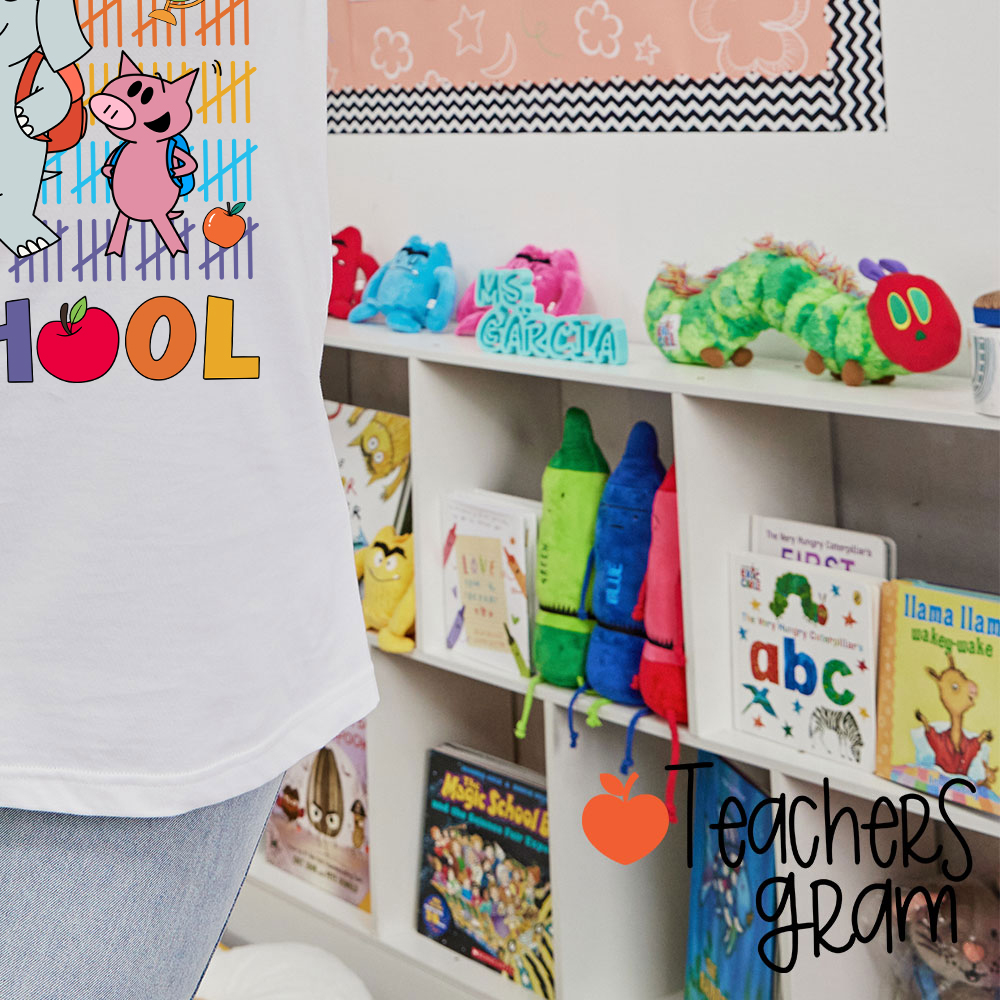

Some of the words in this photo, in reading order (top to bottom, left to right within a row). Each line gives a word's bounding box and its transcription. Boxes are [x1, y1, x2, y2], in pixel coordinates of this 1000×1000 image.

[478, 310, 619, 364] GARCIA
[904, 593, 954, 628] llama
[960, 605, 1000, 637] llam
[911, 626, 994, 658] wakey-wake
[749, 636, 856, 706] abc
[440, 771, 488, 811] Magic
[486, 788, 540, 833] School
